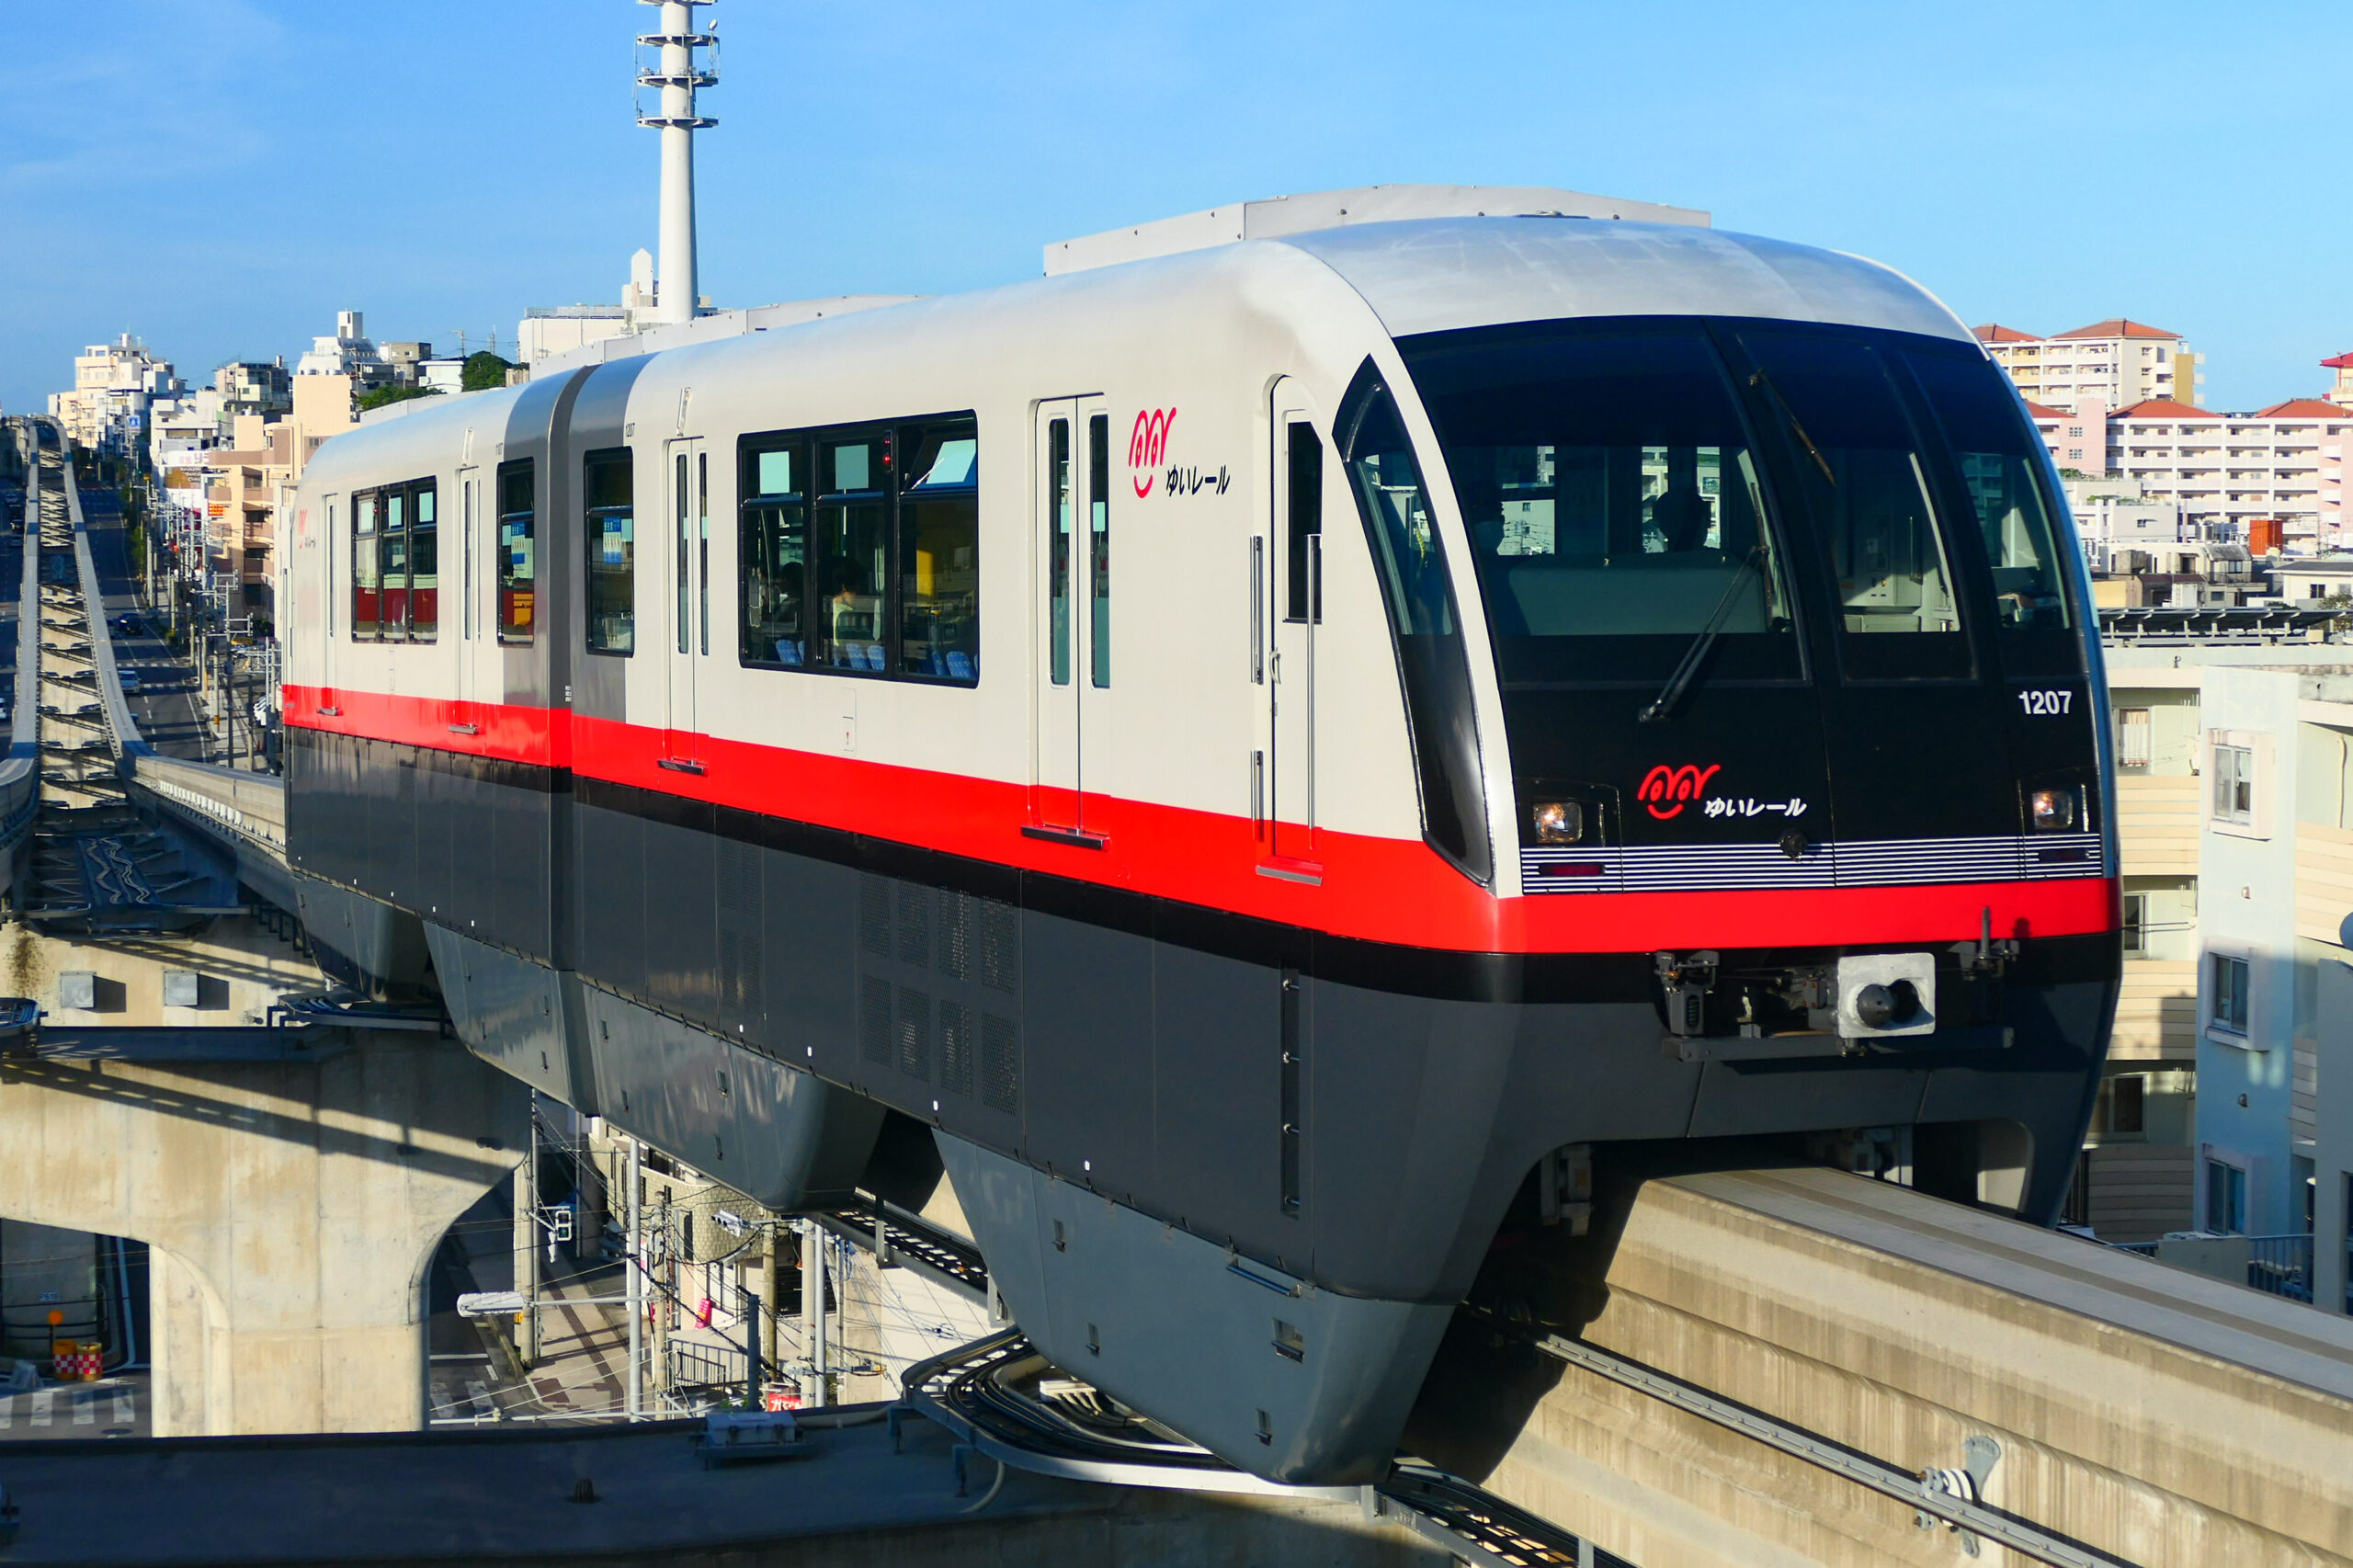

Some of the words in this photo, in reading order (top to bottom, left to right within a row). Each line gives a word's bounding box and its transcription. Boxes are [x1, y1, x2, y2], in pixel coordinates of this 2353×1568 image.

[1165, 464, 1231, 496] ゆいレール
[2018, 690, 2073, 715] 1207
[1704, 797, 1807, 819] ゆいレール
